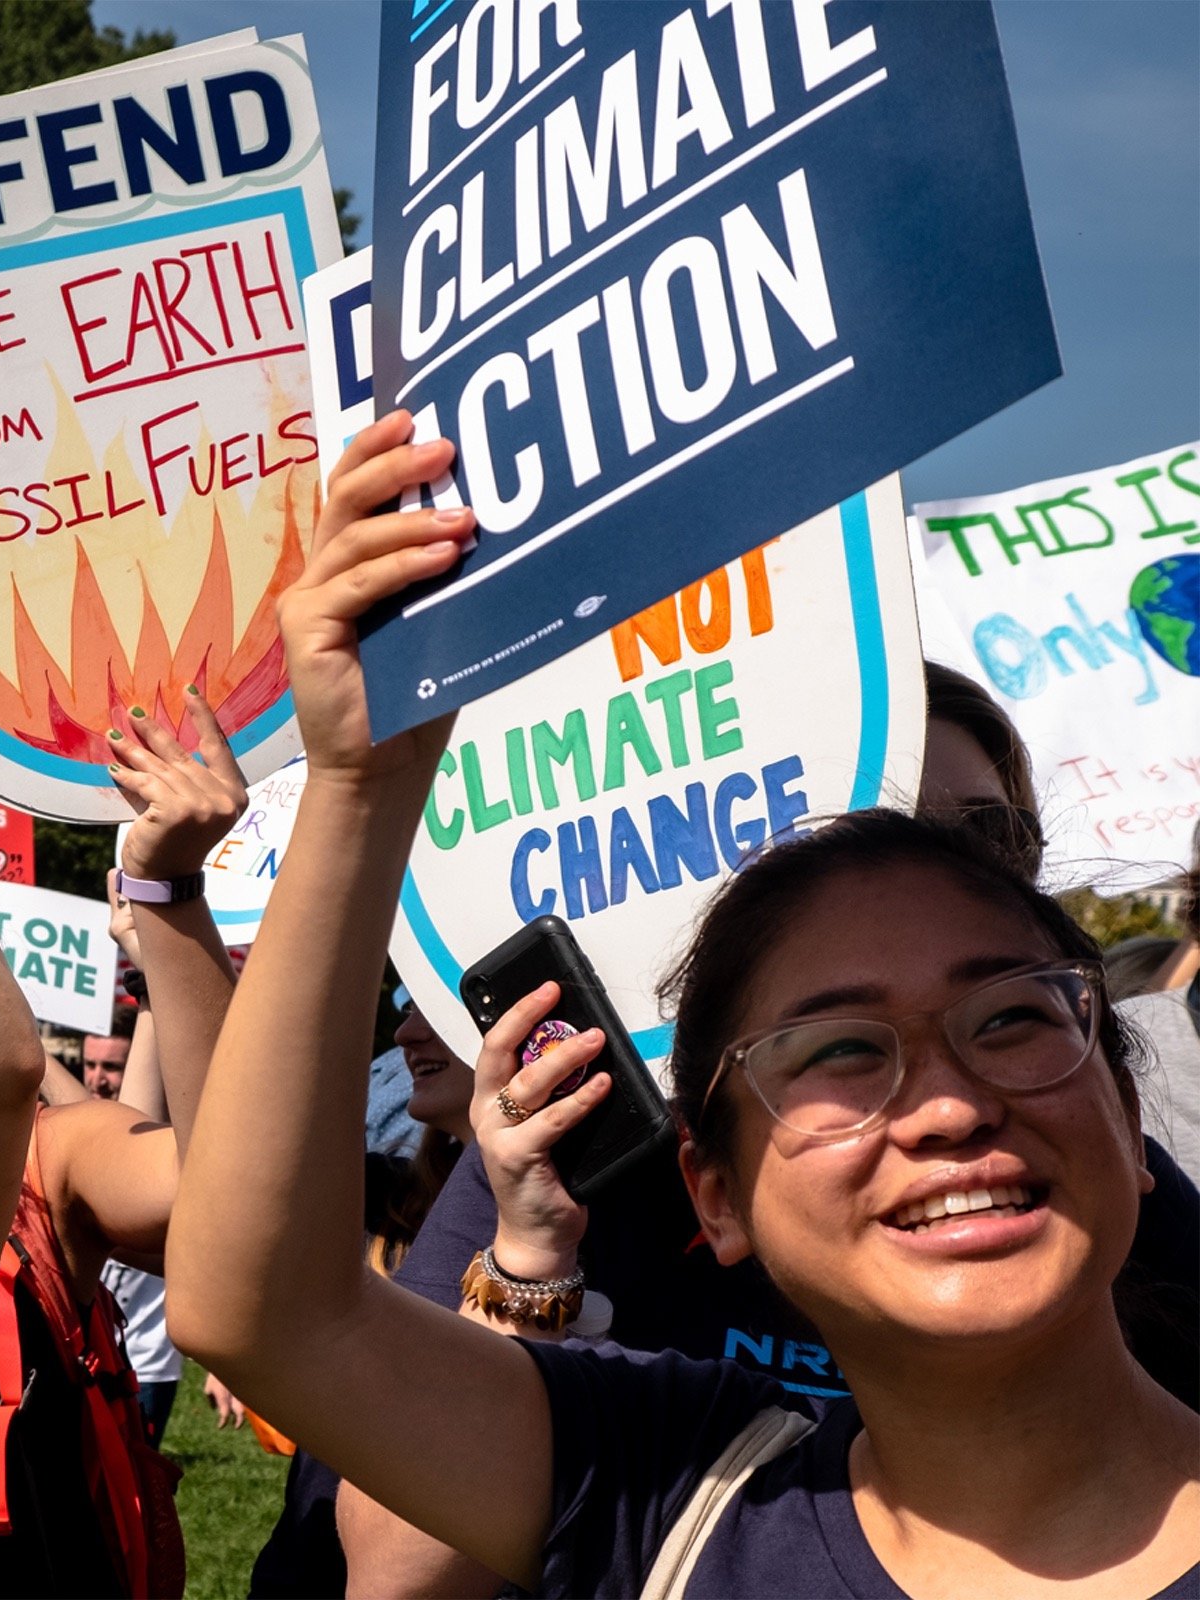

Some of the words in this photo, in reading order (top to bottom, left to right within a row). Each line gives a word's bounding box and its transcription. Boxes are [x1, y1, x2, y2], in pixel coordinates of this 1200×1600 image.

[409, 0, 583, 187] FOR
[400, 0, 877, 361] CLIMATE
[60, 231, 295, 383] EARTH
[140, 401, 319, 516] FUELS
[925, 486, 1116, 577] THIS
[1114, 450, 1200, 545] IS
[610, 535, 781, 683] NOT
[972, 592, 1160, 706] Only
[423, 659, 744, 851] CLIMATE
[1057, 755, 1124, 802] It
[511, 755, 813, 925] CHANGE
[23, 917, 90, 960] ON
[724, 1327, 845, 1380] NR
